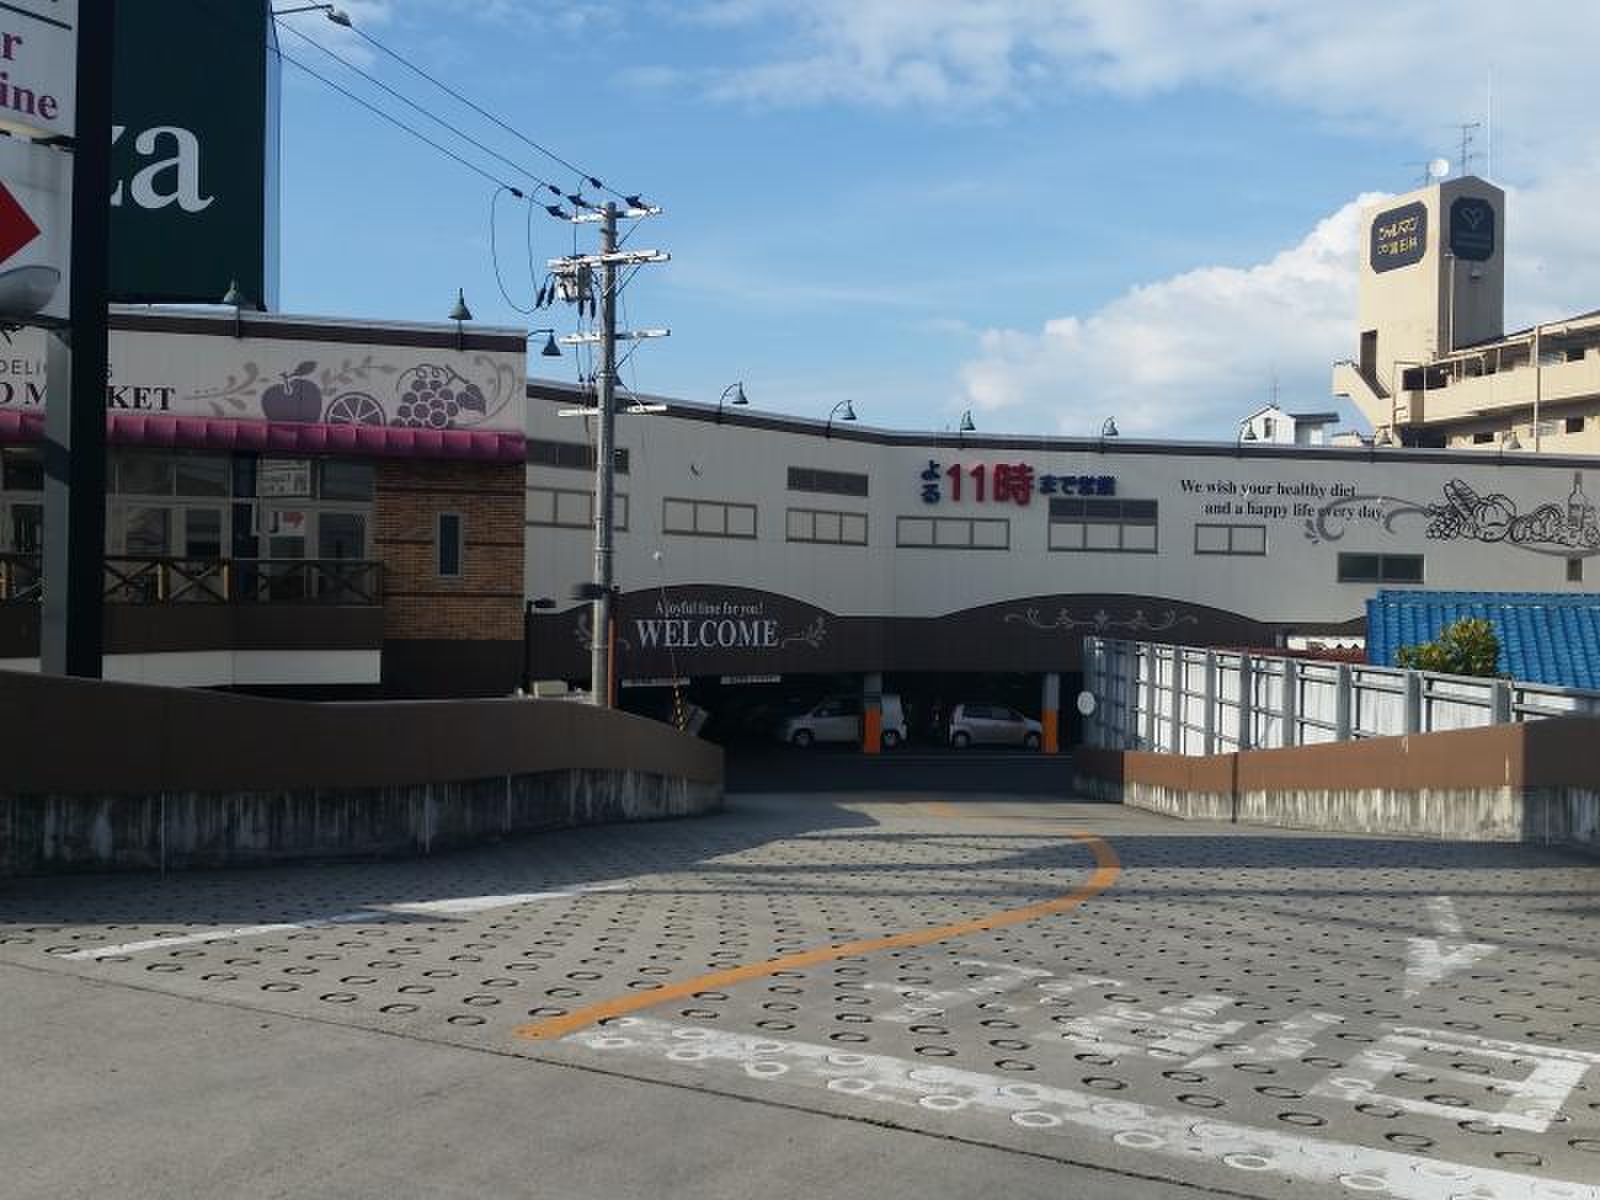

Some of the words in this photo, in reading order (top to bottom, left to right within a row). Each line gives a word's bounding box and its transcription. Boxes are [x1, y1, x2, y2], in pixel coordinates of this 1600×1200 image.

[920, 459, 941, 505] よる
[946, 462, 1034, 506] 11時
[1181, 479, 1202, 494] We
[1206, 481, 1236, 495] wish
[1241, 484, 1273, 499] your
[1277, 482, 1328, 499] healthy
[1330, 483, 1356, 497] diet
[1204, 502, 1231, 515] and
[1235, 505, 1243, 515] a
[1247, 502, 1287, 518] happy
[1293, 503, 1315, 518] life
[1318, 506, 1354, 520] every
[635, 619, 778, 648] WELCOME
